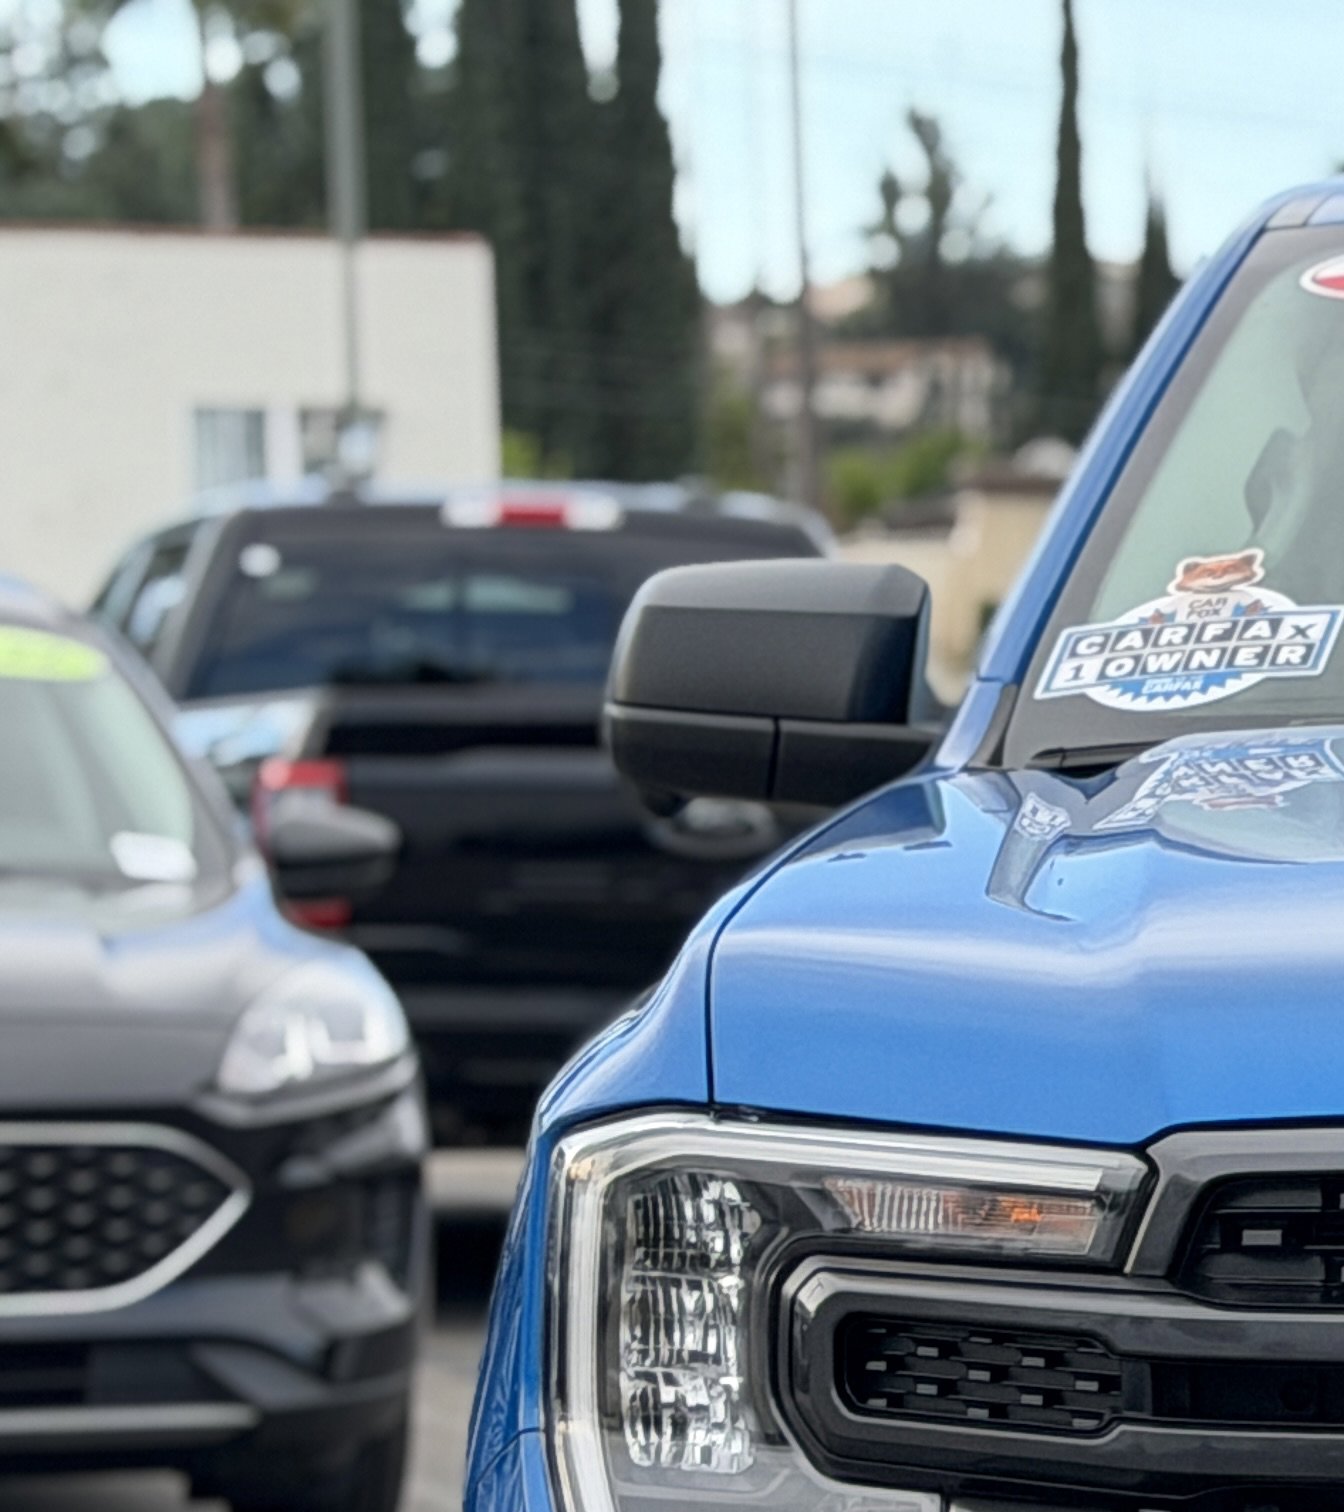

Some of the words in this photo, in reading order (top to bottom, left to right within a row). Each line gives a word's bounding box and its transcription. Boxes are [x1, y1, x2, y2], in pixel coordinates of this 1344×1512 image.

[1075, 618, 1318, 657] CARFAX
[1063, 663, 1088, 682] 1
[1104, 644, 1307, 678] OWNER
